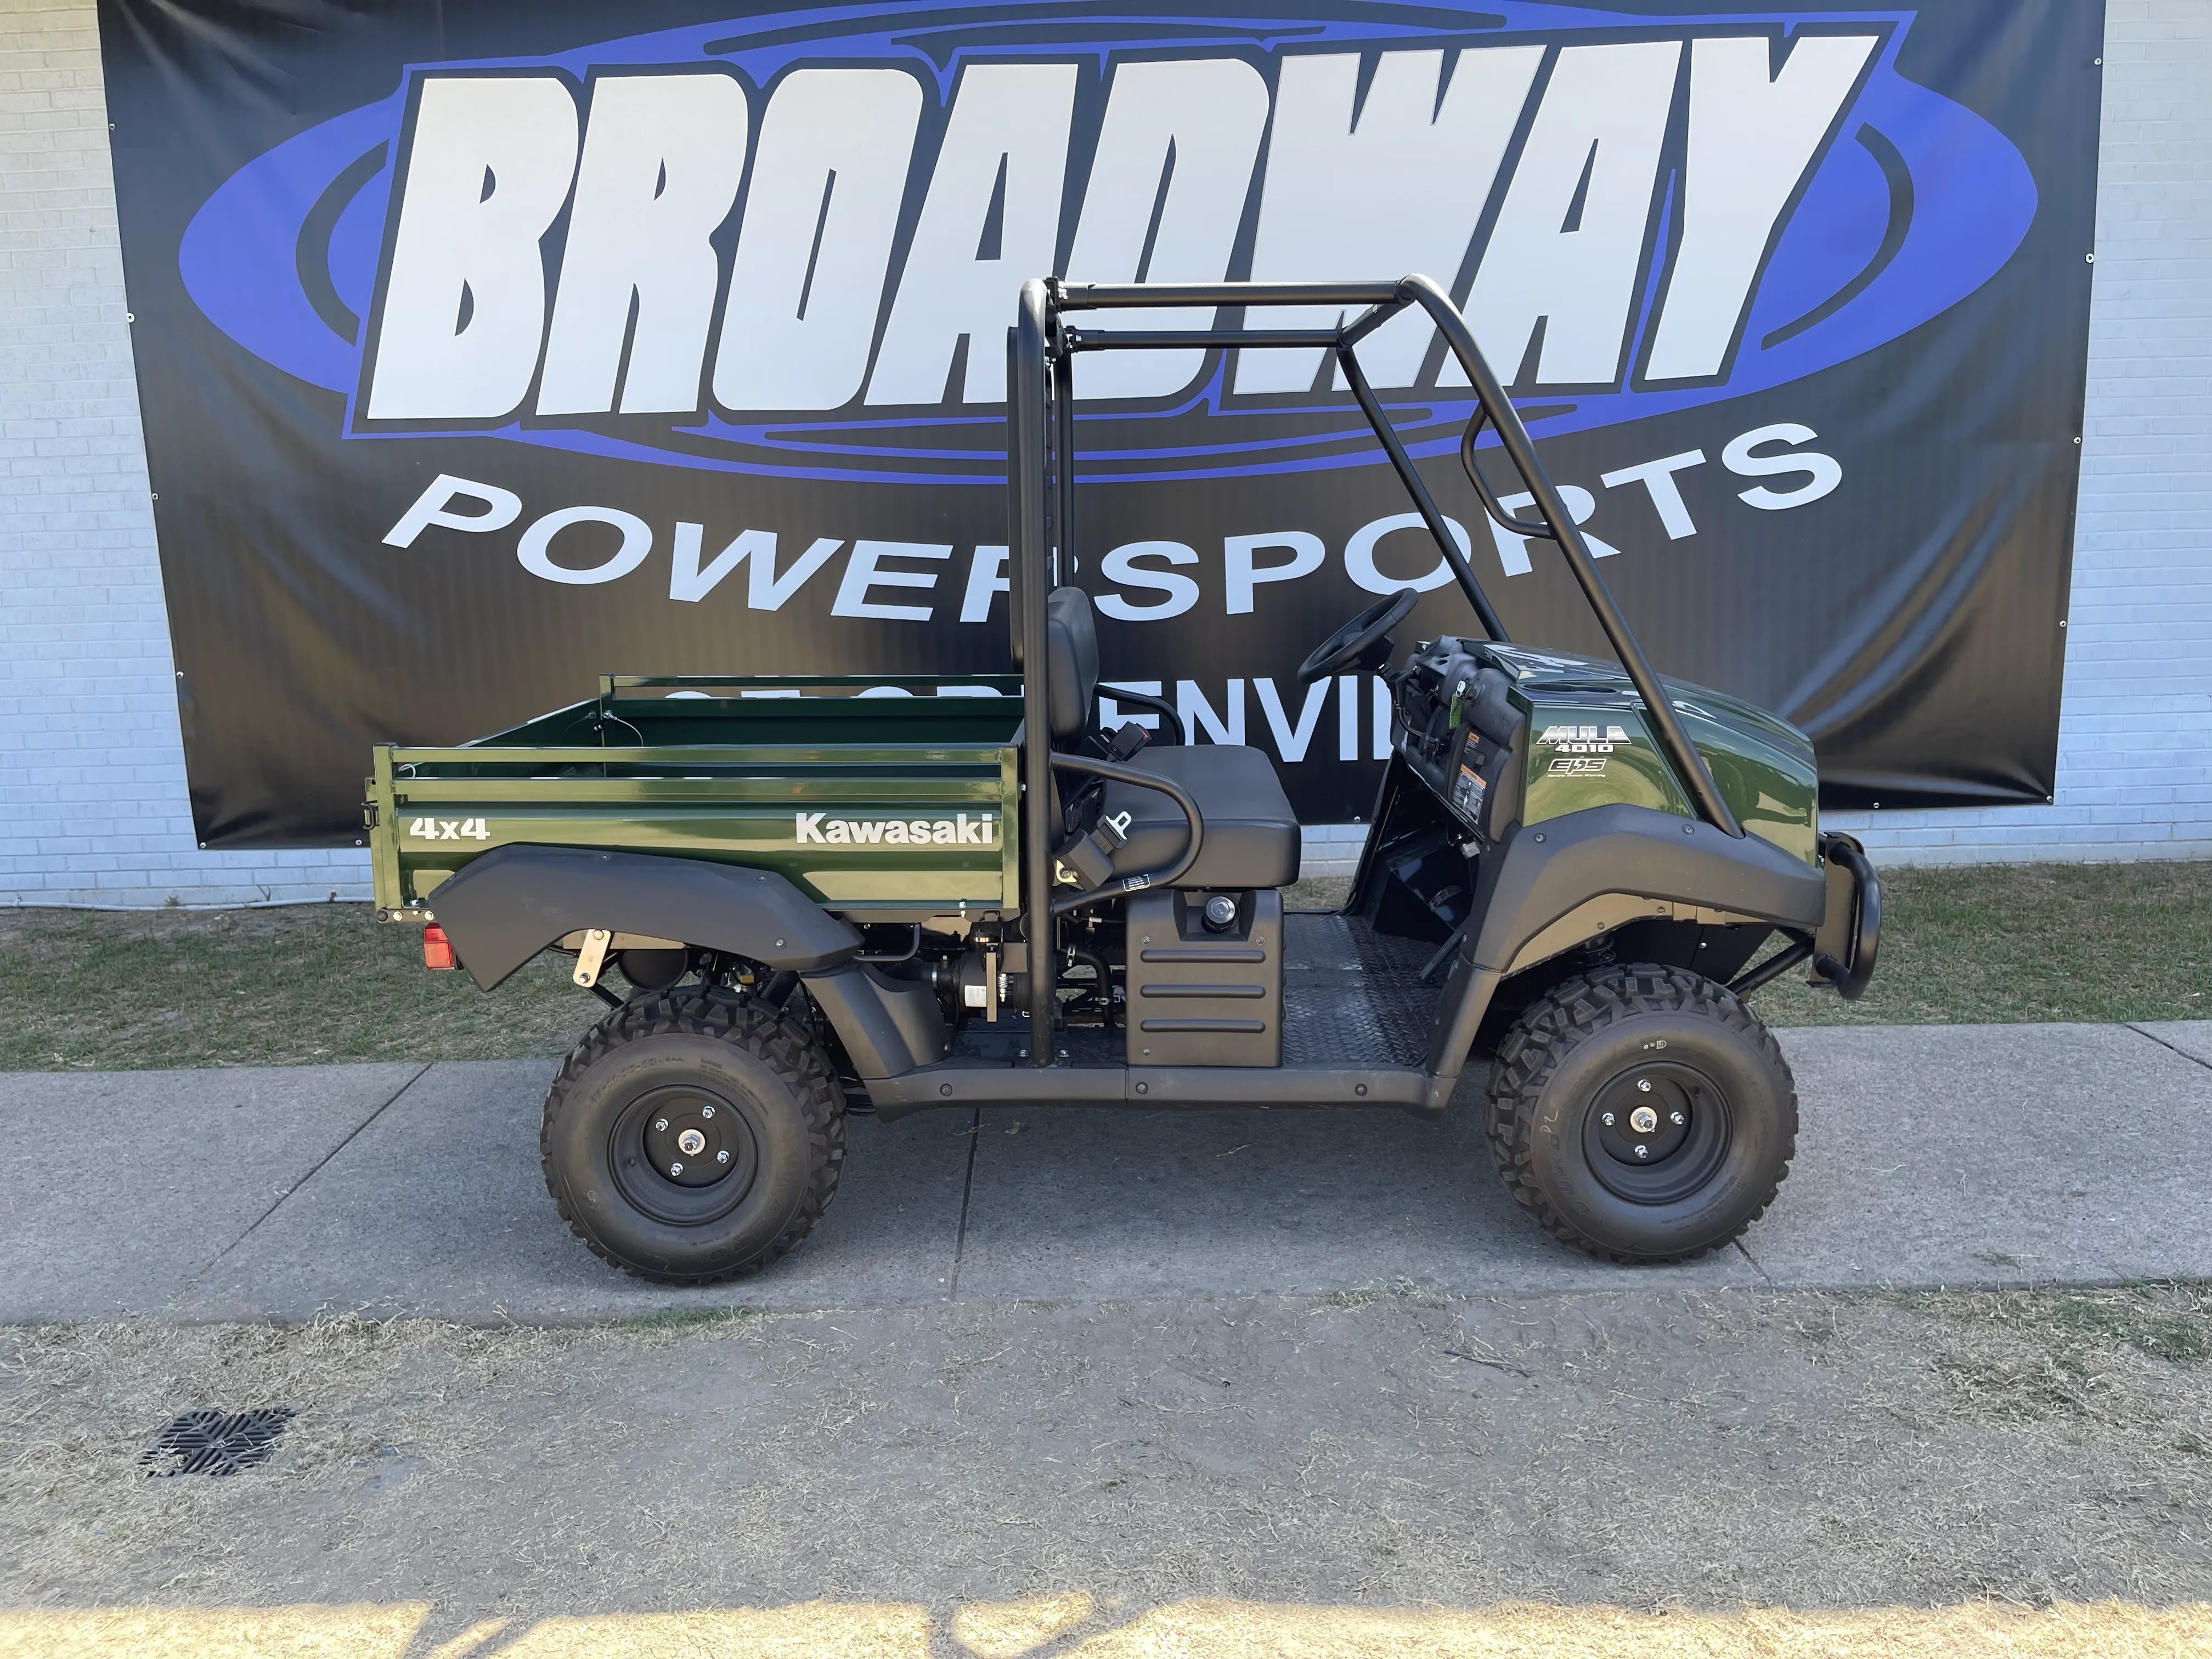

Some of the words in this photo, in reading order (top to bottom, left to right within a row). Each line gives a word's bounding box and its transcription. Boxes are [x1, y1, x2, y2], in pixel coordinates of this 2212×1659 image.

[367, 35, 1879, 421] BROADWAY
[1536, 725, 1632, 745] MULE
[1555, 744, 1613, 753] 4010
[409, 817, 491, 840] 4x4
[795, 812, 993, 844] Kawasaki
